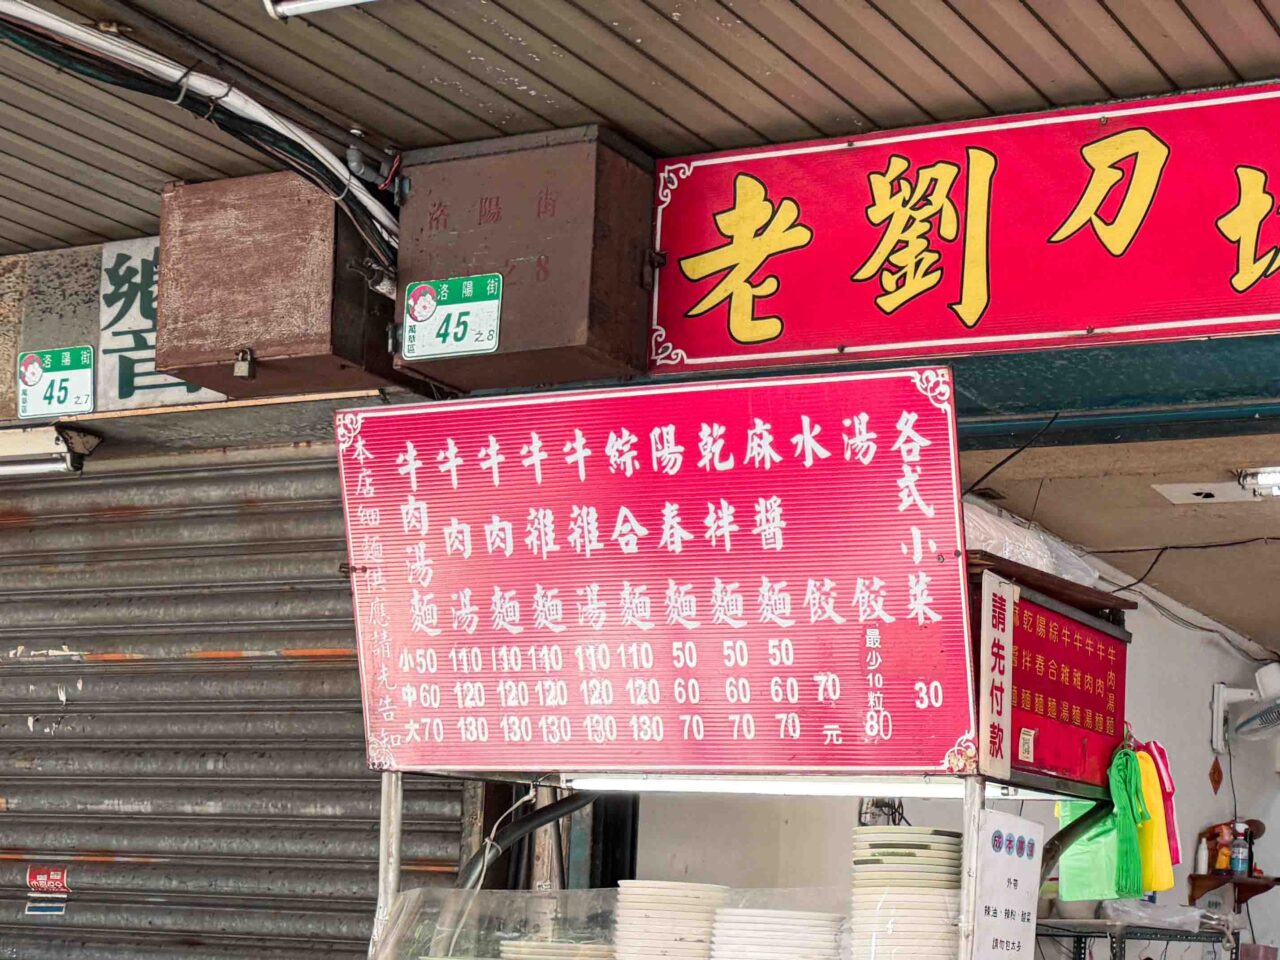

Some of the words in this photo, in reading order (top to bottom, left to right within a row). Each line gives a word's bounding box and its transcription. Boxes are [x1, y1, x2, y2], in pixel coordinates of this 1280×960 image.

[437, 278, 498, 300] 洛陽街
[436, 311, 470, 344] 45
[42, 349, 90, 368] 洛陽街
[43, 377, 69, 405] 45
[890, 410, 942, 625] 各式小菜
[449, 647, 482, 672] 110
[492, 645, 521, 671] 110
[528, 645, 562, 671] 110
[574, 644, 610, 670] 110
[617, 642, 653, 669] 110
[673, 641, 697, 668] 50
[723, 640, 748, 667] 50
[768, 639, 794, 666] 50
[865, 628, 884, 711] 最少10粒
[453, 681, 485, 708] 120
[497, 680, 529, 707] 120
[535, 680, 568, 707] 120
[580, 678, 613, 706] 120
[626, 678, 661, 705] 120
[673, 678, 700, 704] 60
[725, 677, 751, 703] 60
[770, 677, 799, 703] 60
[813, 673, 841, 702] 70
[914, 681, 943, 709] 30
[989, 592, 1007, 760] 請先付款
[457, 716, 489, 742] 130
[500, 715, 532, 742] 130
[538, 715, 571, 744] 130
[583, 714, 617, 743] 130
[629, 715, 664, 741] 130
[680, 714, 704, 740] 70
[728, 714, 755, 739] 70
[775, 712, 800, 739] 70
[822, 724, 843, 745] 元
[865, 711, 892, 740] 80
